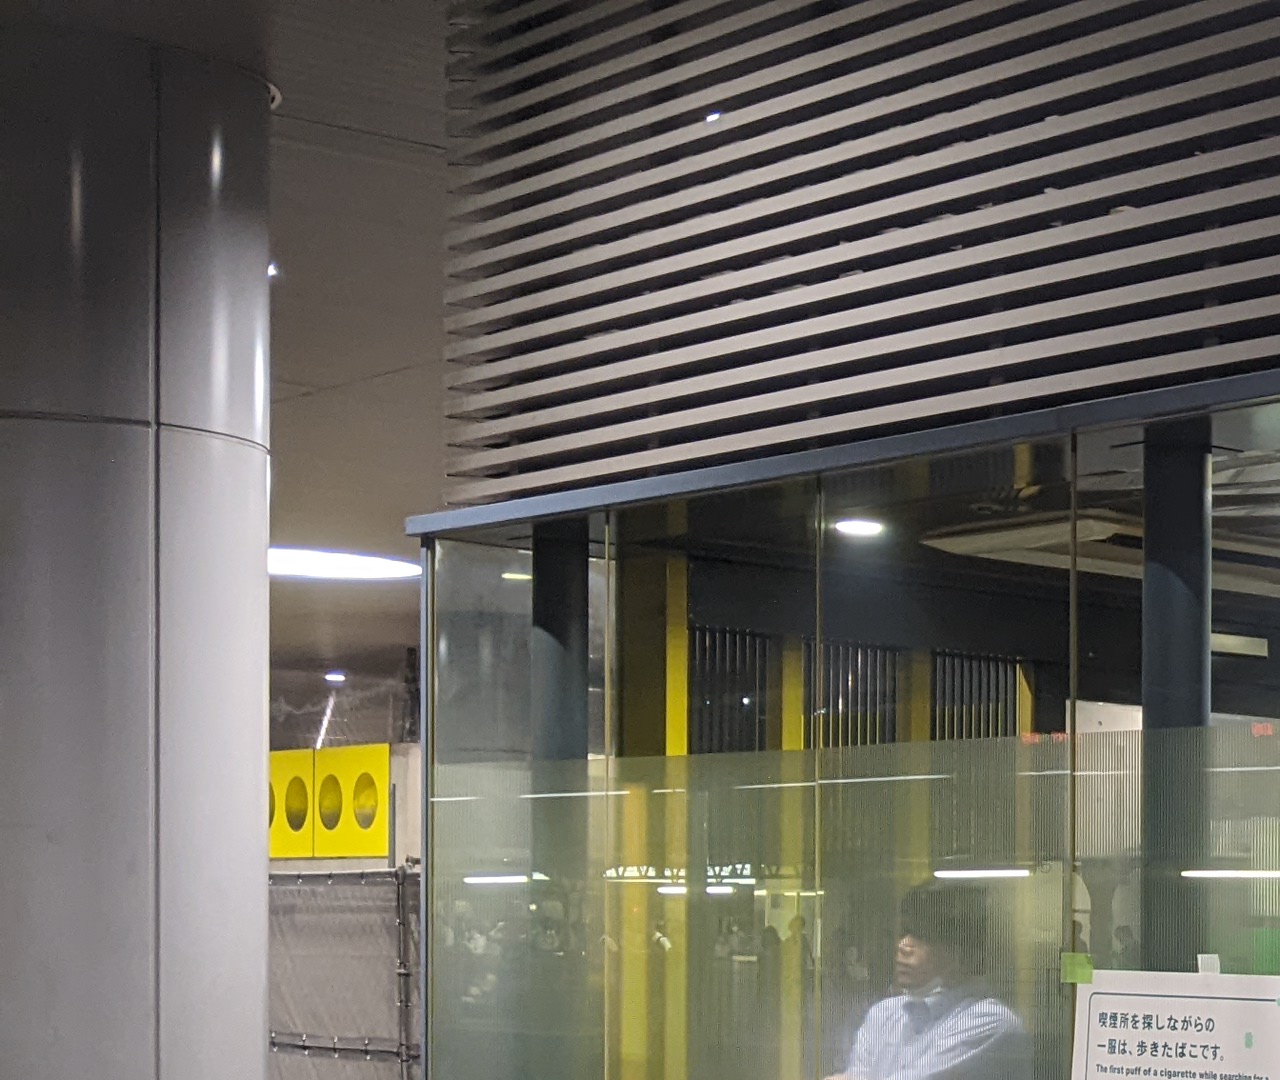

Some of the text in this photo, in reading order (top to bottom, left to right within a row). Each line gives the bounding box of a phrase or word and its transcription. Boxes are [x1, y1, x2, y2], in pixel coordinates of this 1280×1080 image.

[1098, 1012, 1215, 1032] 喫煙所を探しながらの
[1097, 1038, 1224, 1061] 一服は、歩きたばこです。
[1096, 1064, 1107, 1073] The
[1109, 1065, 1124, 1075] first
[1125, 1066, 1141, 1077] puff
[1143, 1067, 1152, 1076] of
[1160, 1068, 1197, 1080] cigarette
[1199, 1071, 1217, 1080] while
